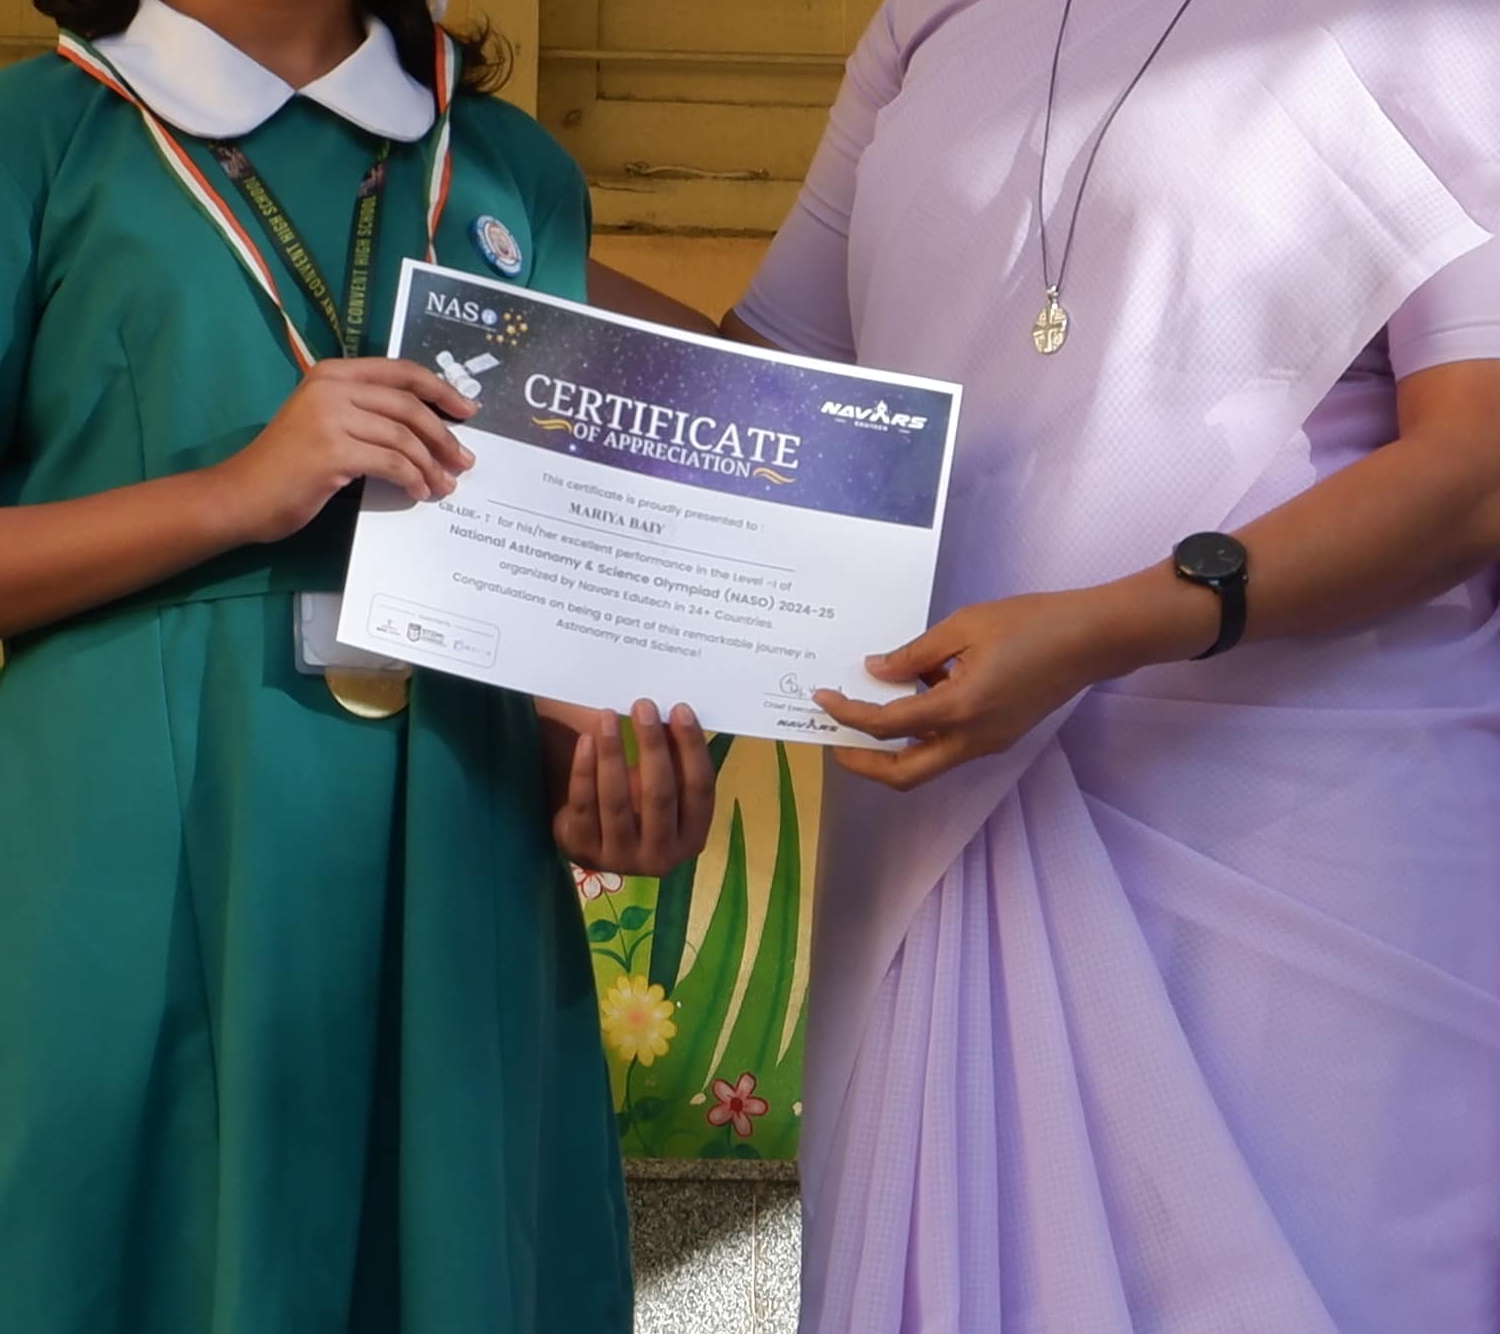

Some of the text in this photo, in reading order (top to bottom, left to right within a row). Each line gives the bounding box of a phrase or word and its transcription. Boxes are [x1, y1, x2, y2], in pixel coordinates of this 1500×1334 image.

[244, 176, 277, 216] SCHOOL
[357, 195, 377, 236] SCHOOL
[269, 214, 295, 243] HIGH
[354, 238, 371, 266] HIGH
[286, 241, 325, 297] CONVENT
[347, 269, 368, 323] CONVENT
[524, 373, 801, 469] CERTIFICATE
[573, 422, 751, 478] OF APPRECIATION
[542, 472, 563, 487] This
[566, 479, 623, 501] certificate
[637, 498, 681, 516] proudly
[684, 507, 742, 529] presented
[568, 502, 625, 526] MARIYA
[449, 523, 505, 548] National
[509, 541, 581, 570] Astronomy
[597, 563, 649, 585] Science
[653, 575, 720, 599] Olympiad
[724, 587, 776, 611] (NASO)
[779, 600, 835, 619] 2024-25
[498, 516, 514, 529] for
[516, 521, 558, 540] his/her
[561, 534, 612, 554] excellent
[614, 547, 693, 572] performance
[710, 568, 730, 580] the
[733, 572, 763, 586] Level
[499, 560, 558, 583] organized
[560, 576, 576, 589] by
[578, 580, 620, 598] Navars
[623, 591, 671, 610] Edutech
[452, 571, 546, 605] Congratulations
[549, 598, 565, 609] on
[567, 602, 601, 621] being
[615, 614, 641, 627] part
[658, 621, 680, 636] this
[682, 629, 753, 650] remarkable
[755, 643, 801, 660] journey
[556, 618, 620, 643] Astronomy
[623, 636, 648, 648] and
